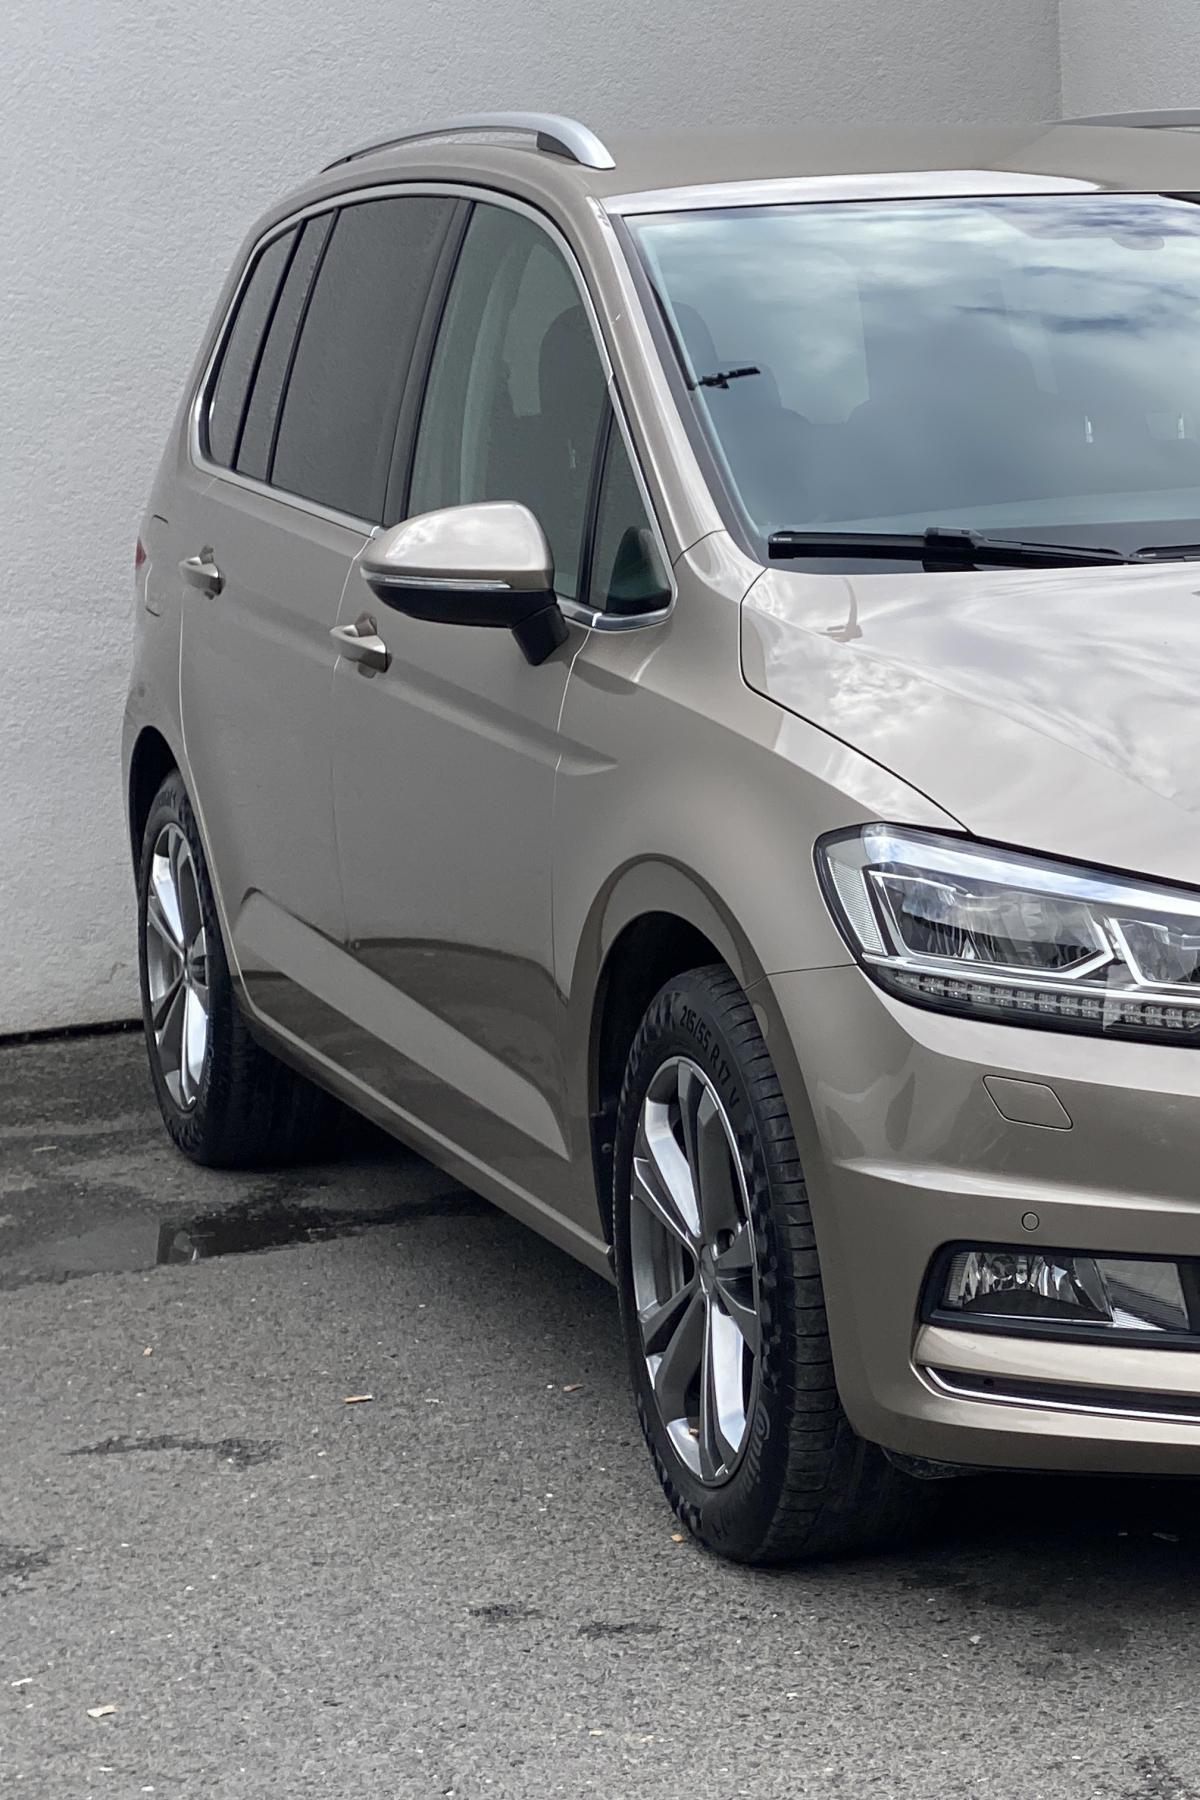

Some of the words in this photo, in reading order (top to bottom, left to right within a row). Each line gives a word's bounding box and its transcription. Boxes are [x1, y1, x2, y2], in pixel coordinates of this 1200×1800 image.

[680, 1005, 712, 1052] 215/55
[710, 1043, 720, 1069] R
[719, 1060, 731, 1086] 17
